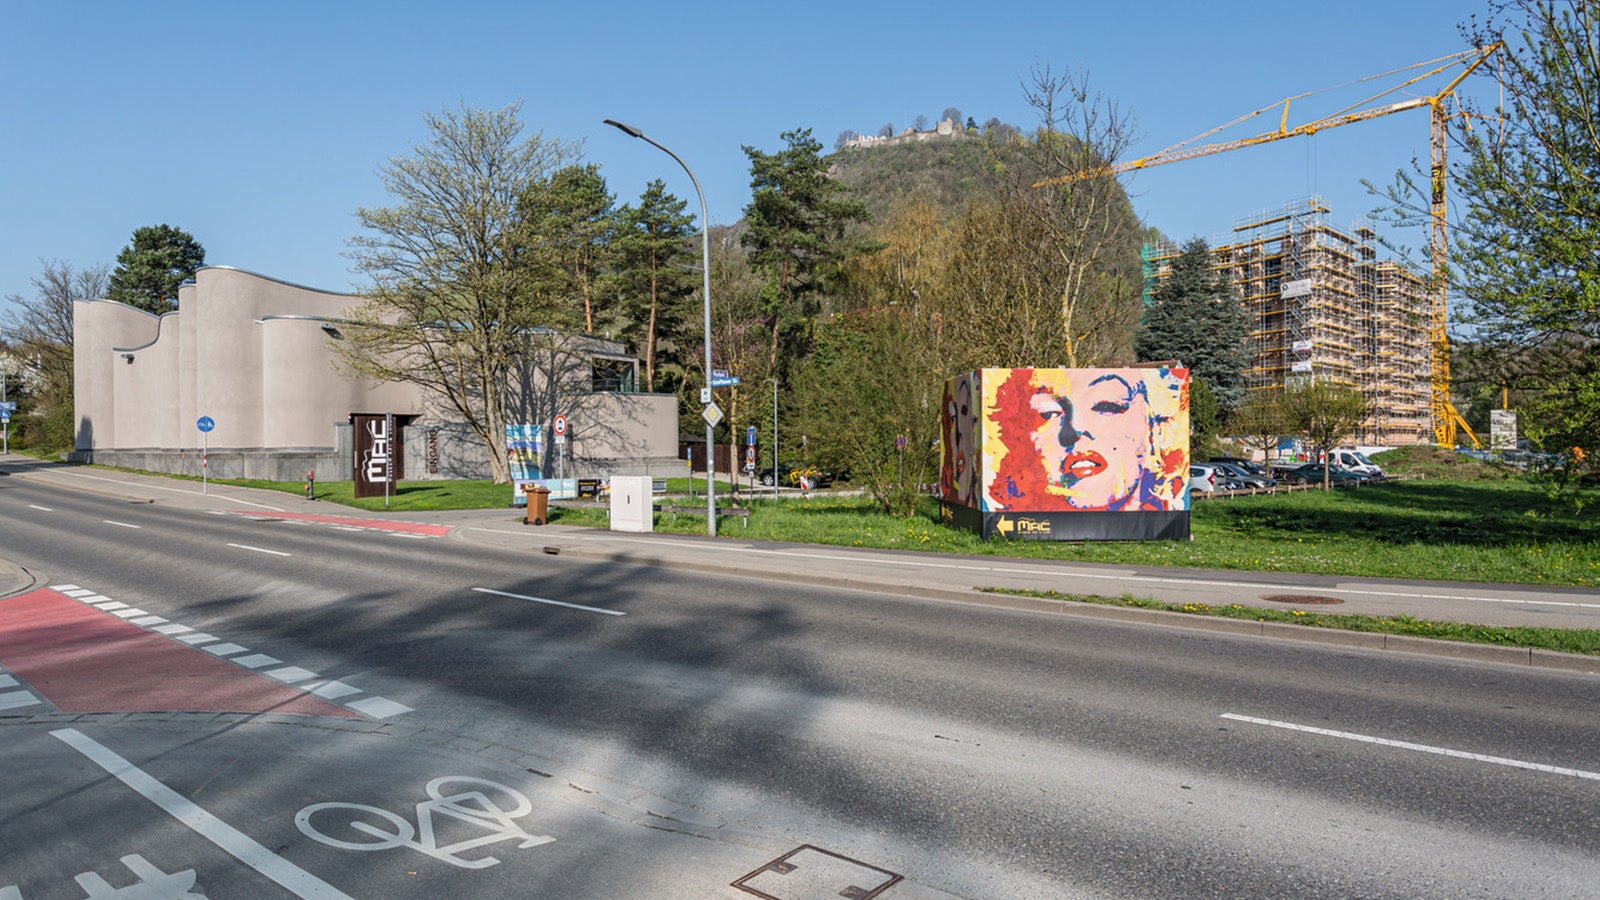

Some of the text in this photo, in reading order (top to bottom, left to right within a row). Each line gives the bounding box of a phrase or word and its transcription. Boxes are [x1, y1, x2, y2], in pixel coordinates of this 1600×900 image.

[367, 420, 387, 482] MAC
[429, 429, 438, 474] EINGANG
[1017, 518, 1051, 531] MAC
